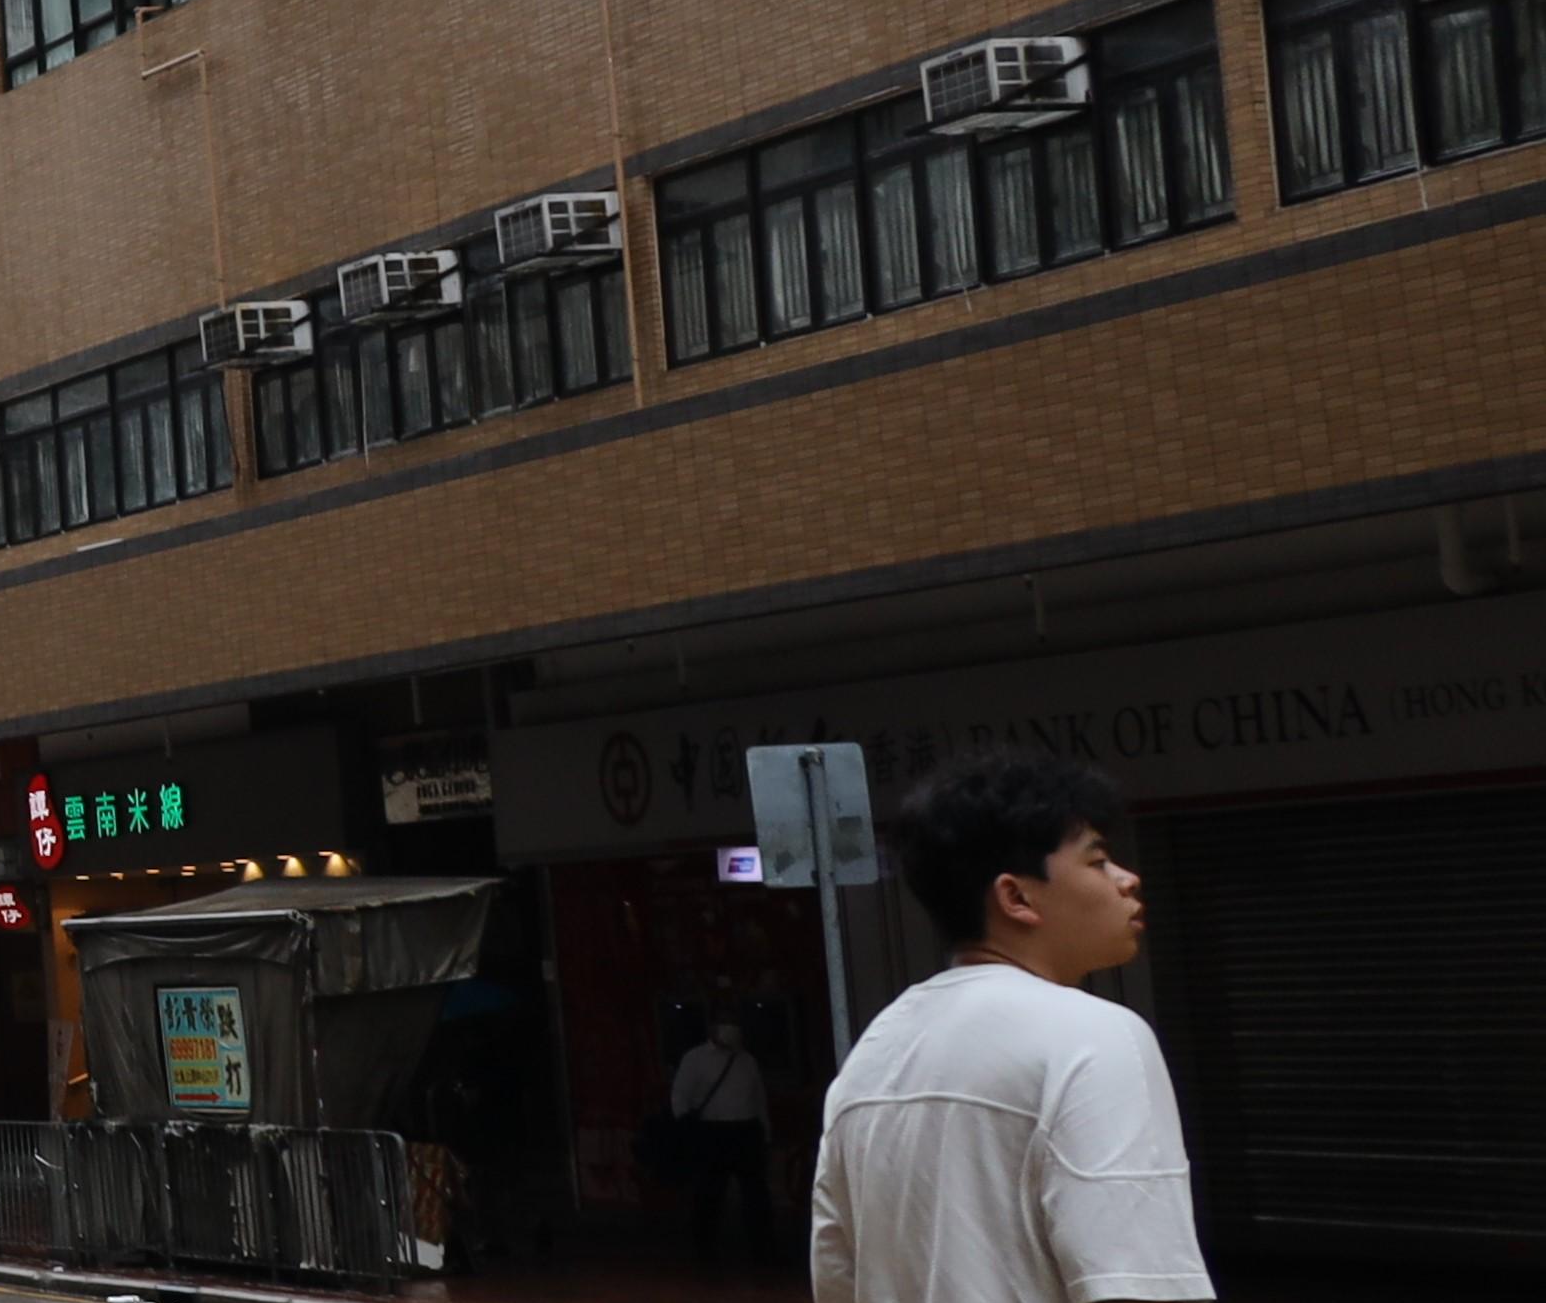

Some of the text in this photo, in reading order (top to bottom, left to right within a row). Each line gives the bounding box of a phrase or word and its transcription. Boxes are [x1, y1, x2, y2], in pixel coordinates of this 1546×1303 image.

[1112, 702, 1175, 758] OF
[1192, 684, 1373, 751] CHINA
[28, 789, 57, 857] 譚仔
[64, 782, 185, 841] 雲南米線
[216, 1002, 242, 1097] 跌打
